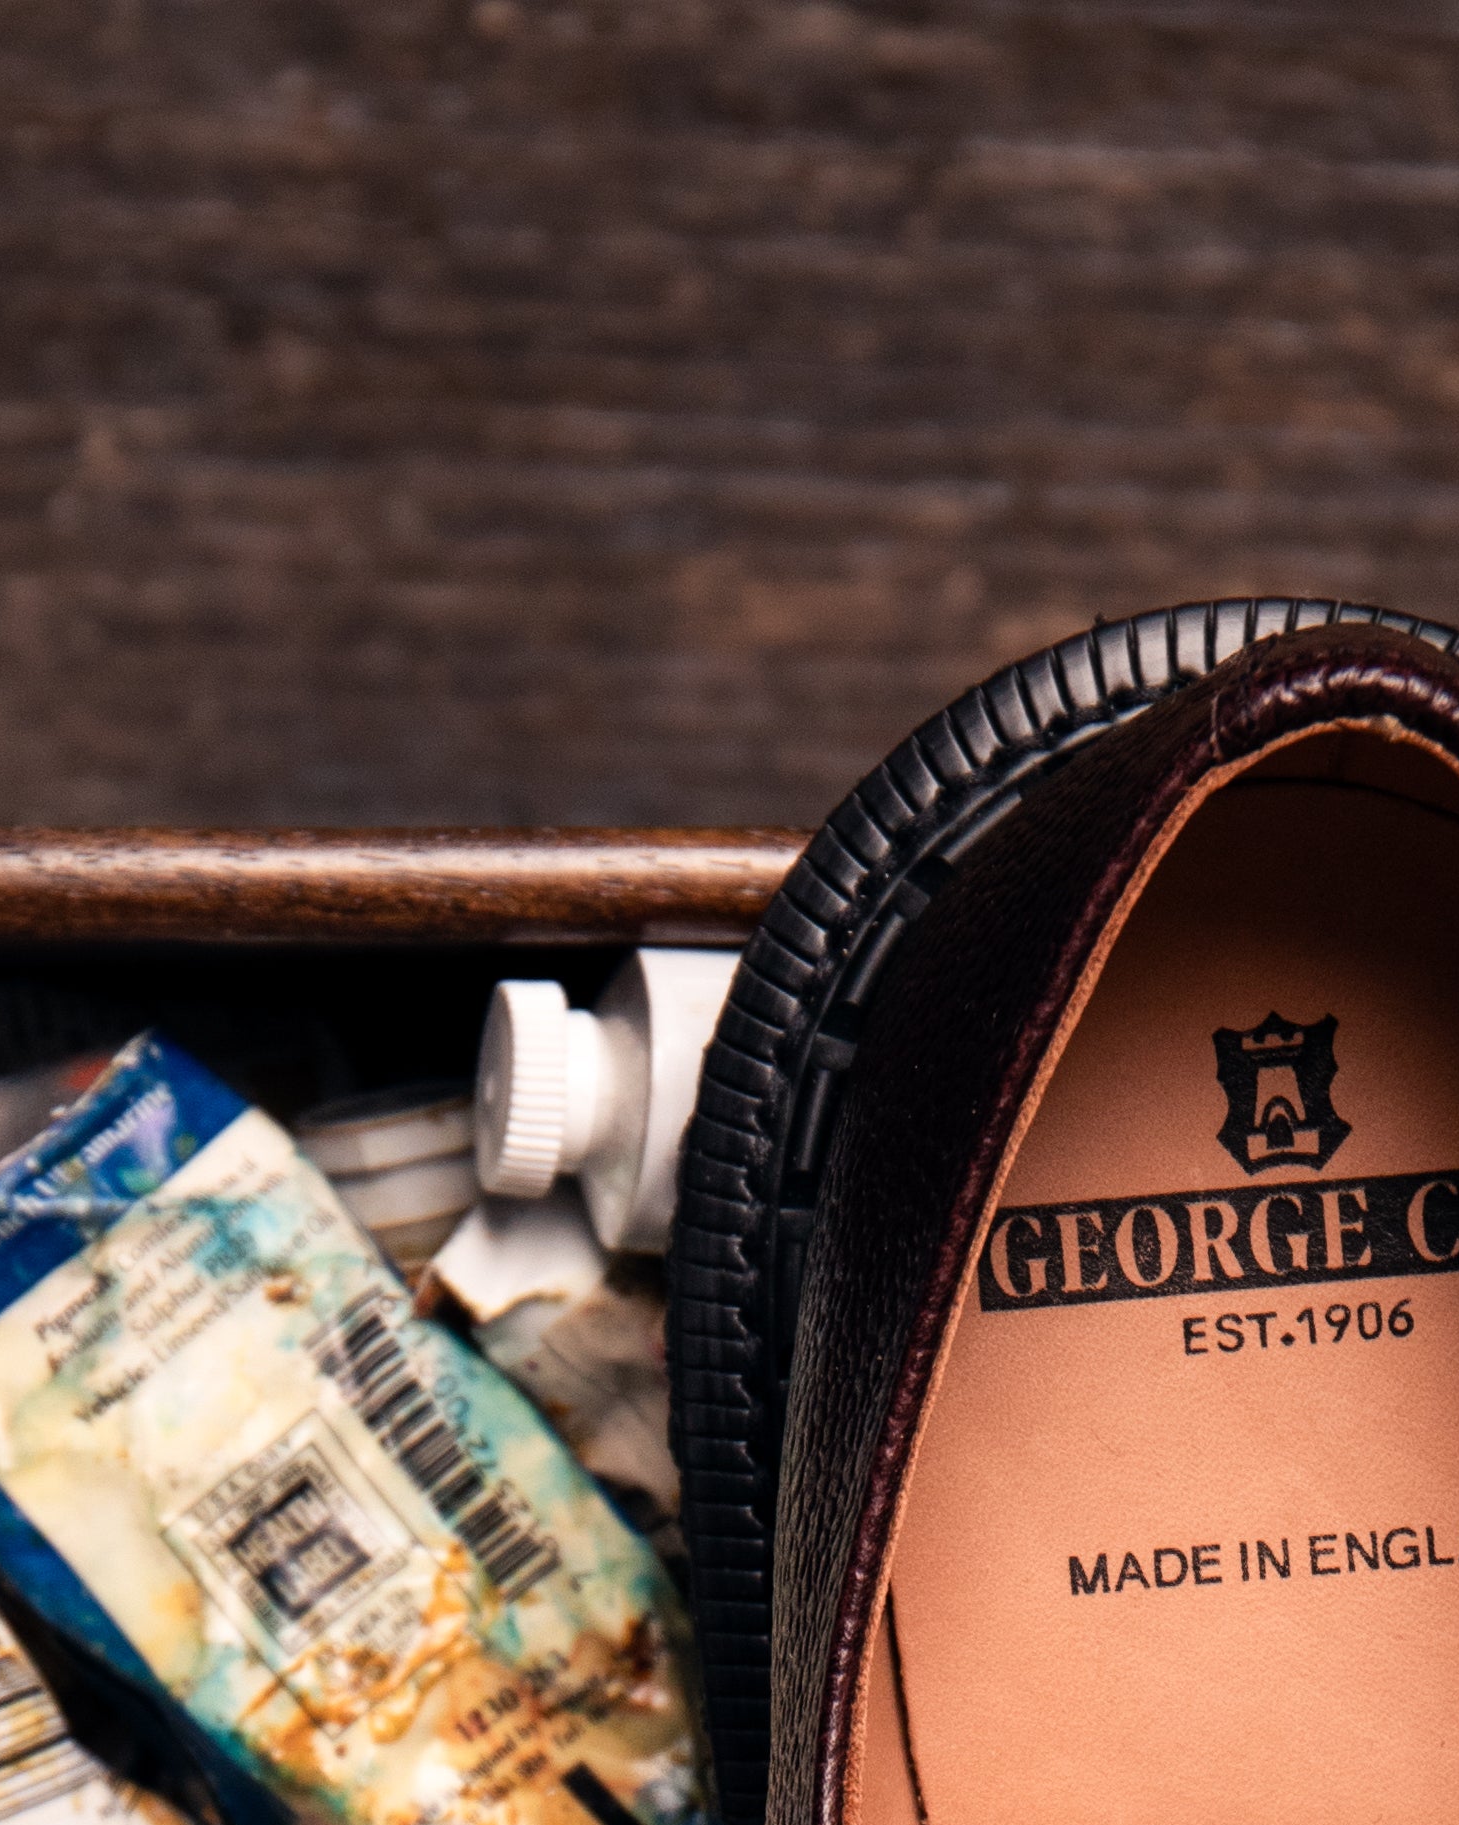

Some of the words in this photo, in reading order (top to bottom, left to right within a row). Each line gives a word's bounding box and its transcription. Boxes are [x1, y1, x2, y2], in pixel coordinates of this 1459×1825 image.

[989, 1186, 1373, 1299] GEORGE
[1182, 1299, 1415, 1356] EST.1906
[1069, 1544, 1224, 1596] MADE
[1239, 1537, 1290, 1582] IN
